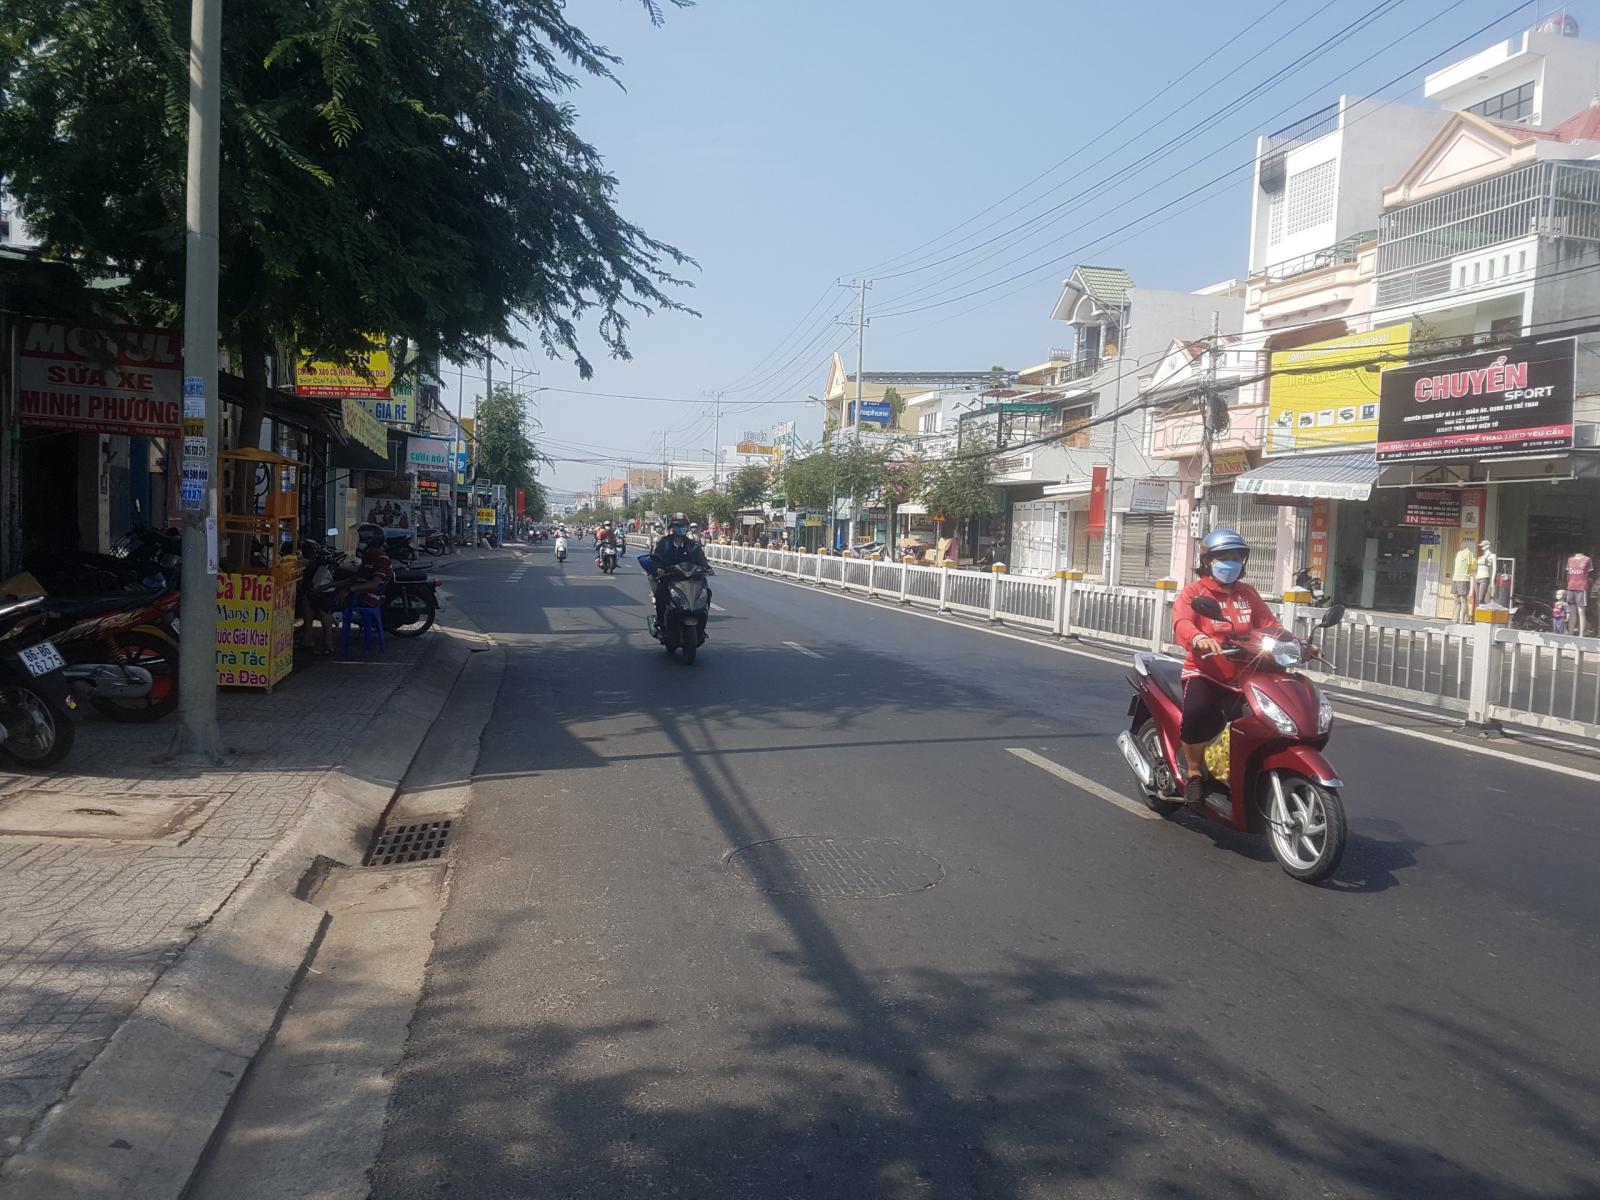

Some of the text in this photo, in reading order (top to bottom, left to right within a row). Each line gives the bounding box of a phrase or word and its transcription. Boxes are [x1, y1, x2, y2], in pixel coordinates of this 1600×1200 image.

[118, 373, 153, 390] XE
[1414, 356, 1528, 402] CHUYỂN
[1504, 385, 1556, 402] SPORT
[20, 391, 80, 416] MINH
[88, 396, 179, 424] PHƯƠNG
[1406, 515, 1419, 524] IN
[240, 576, 272, 602] Phê
[216, 628, 231, 644] ước
[240, 650, 266, 667] Tắc
[216, 669, 267, 685] rà Đào
